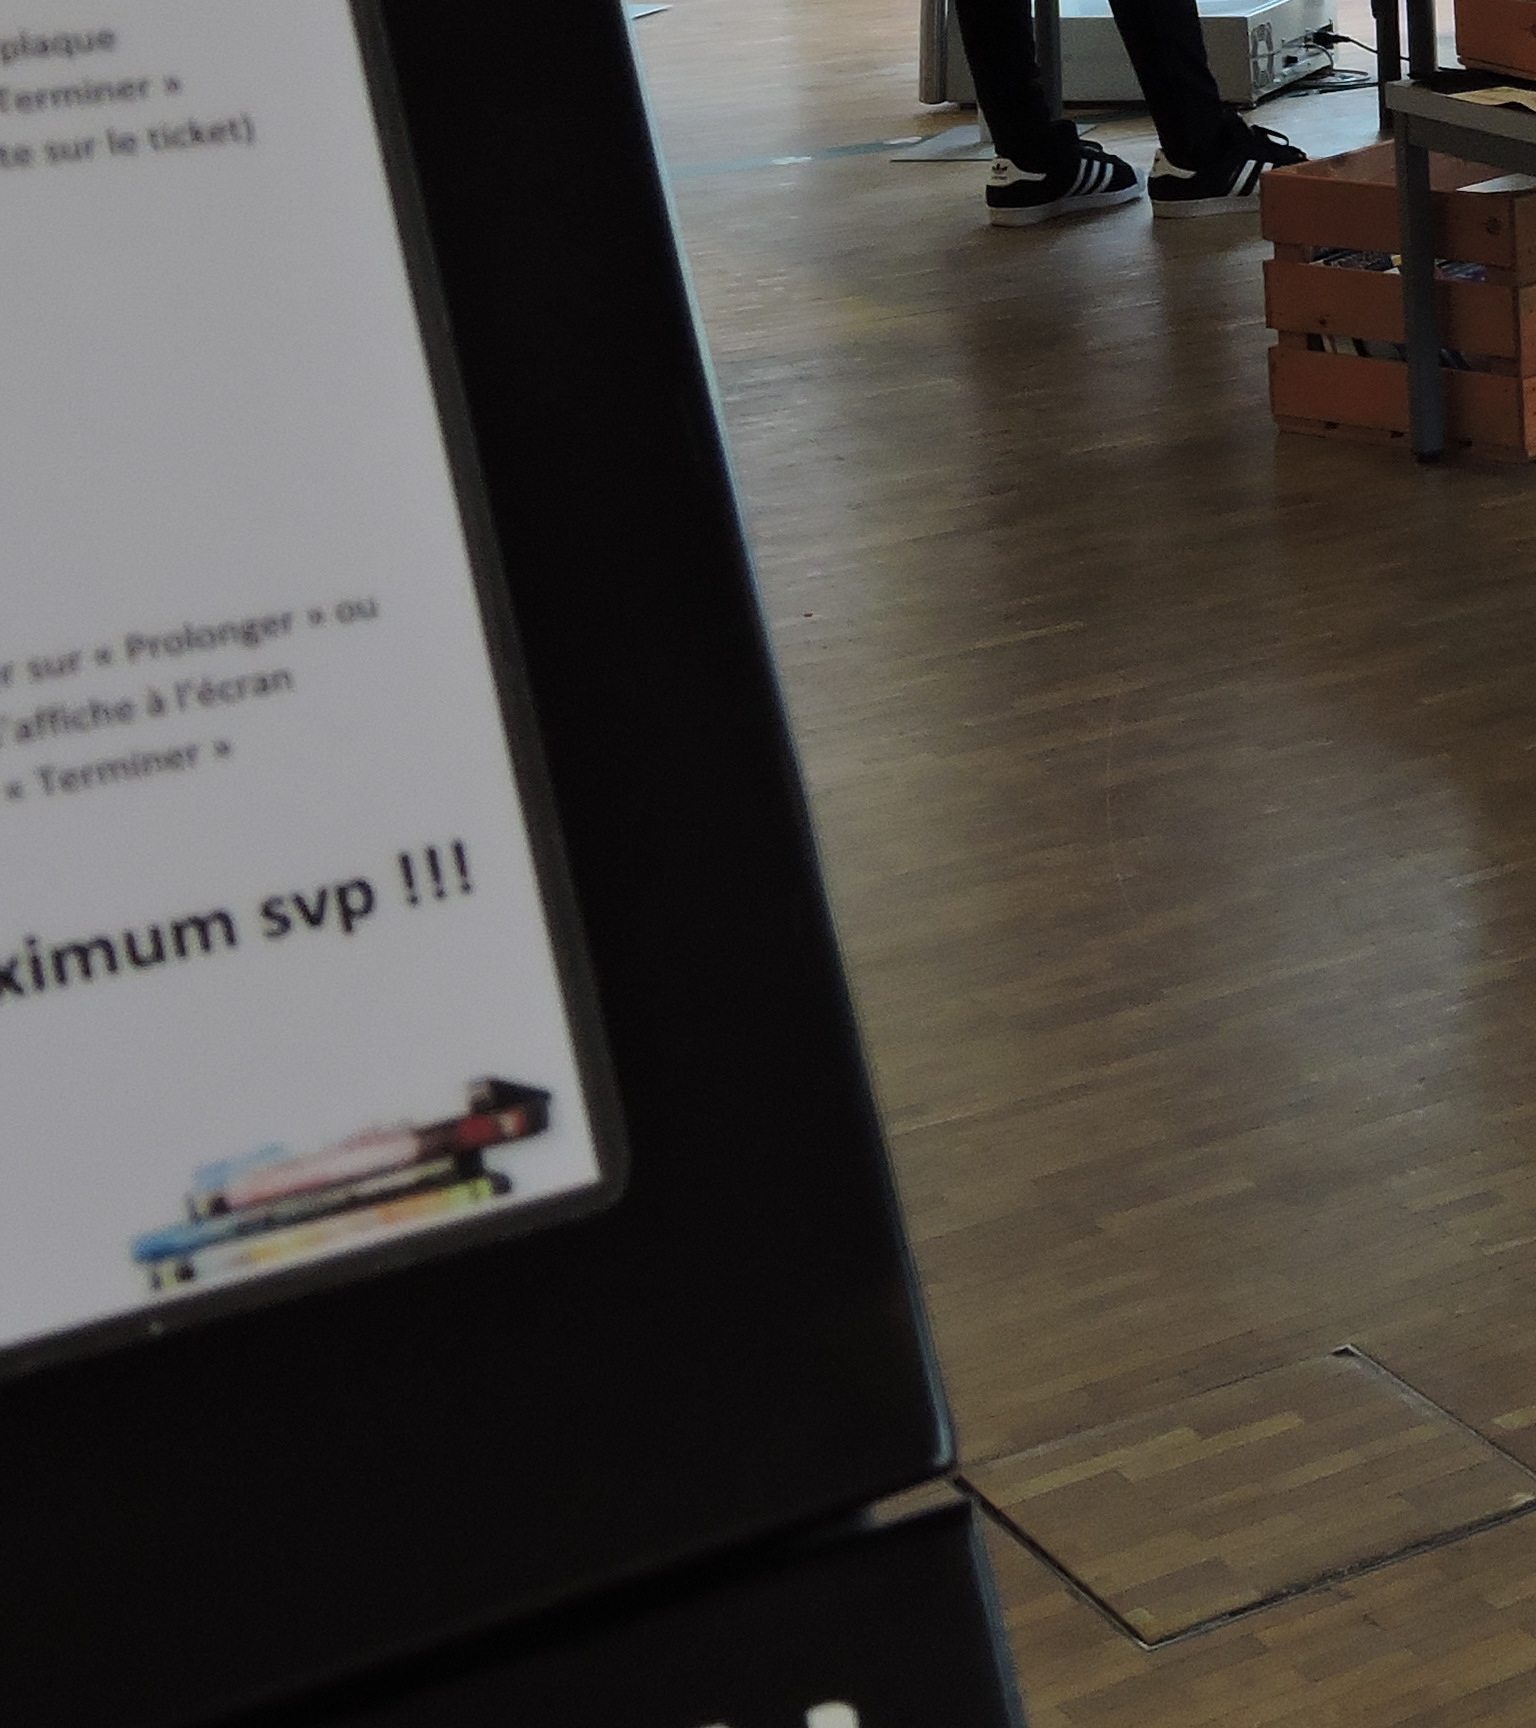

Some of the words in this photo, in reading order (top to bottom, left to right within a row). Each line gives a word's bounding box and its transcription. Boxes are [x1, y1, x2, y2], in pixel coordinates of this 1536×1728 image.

[46, 137, 96, 165] sur
[105, 126, 140, 157] le
[147, 112, 257, 153] ticket)
[27, 650, 82, 683] sur
[125, 609, 294, 662] Prolonger
[335, 597, 379, 624] ou
[147, 688, 167, 718] à
[36, 744, 200, 797] Terminer
[259, 876, 377, 937] svp
[398, 838, 474, 908] !!!
